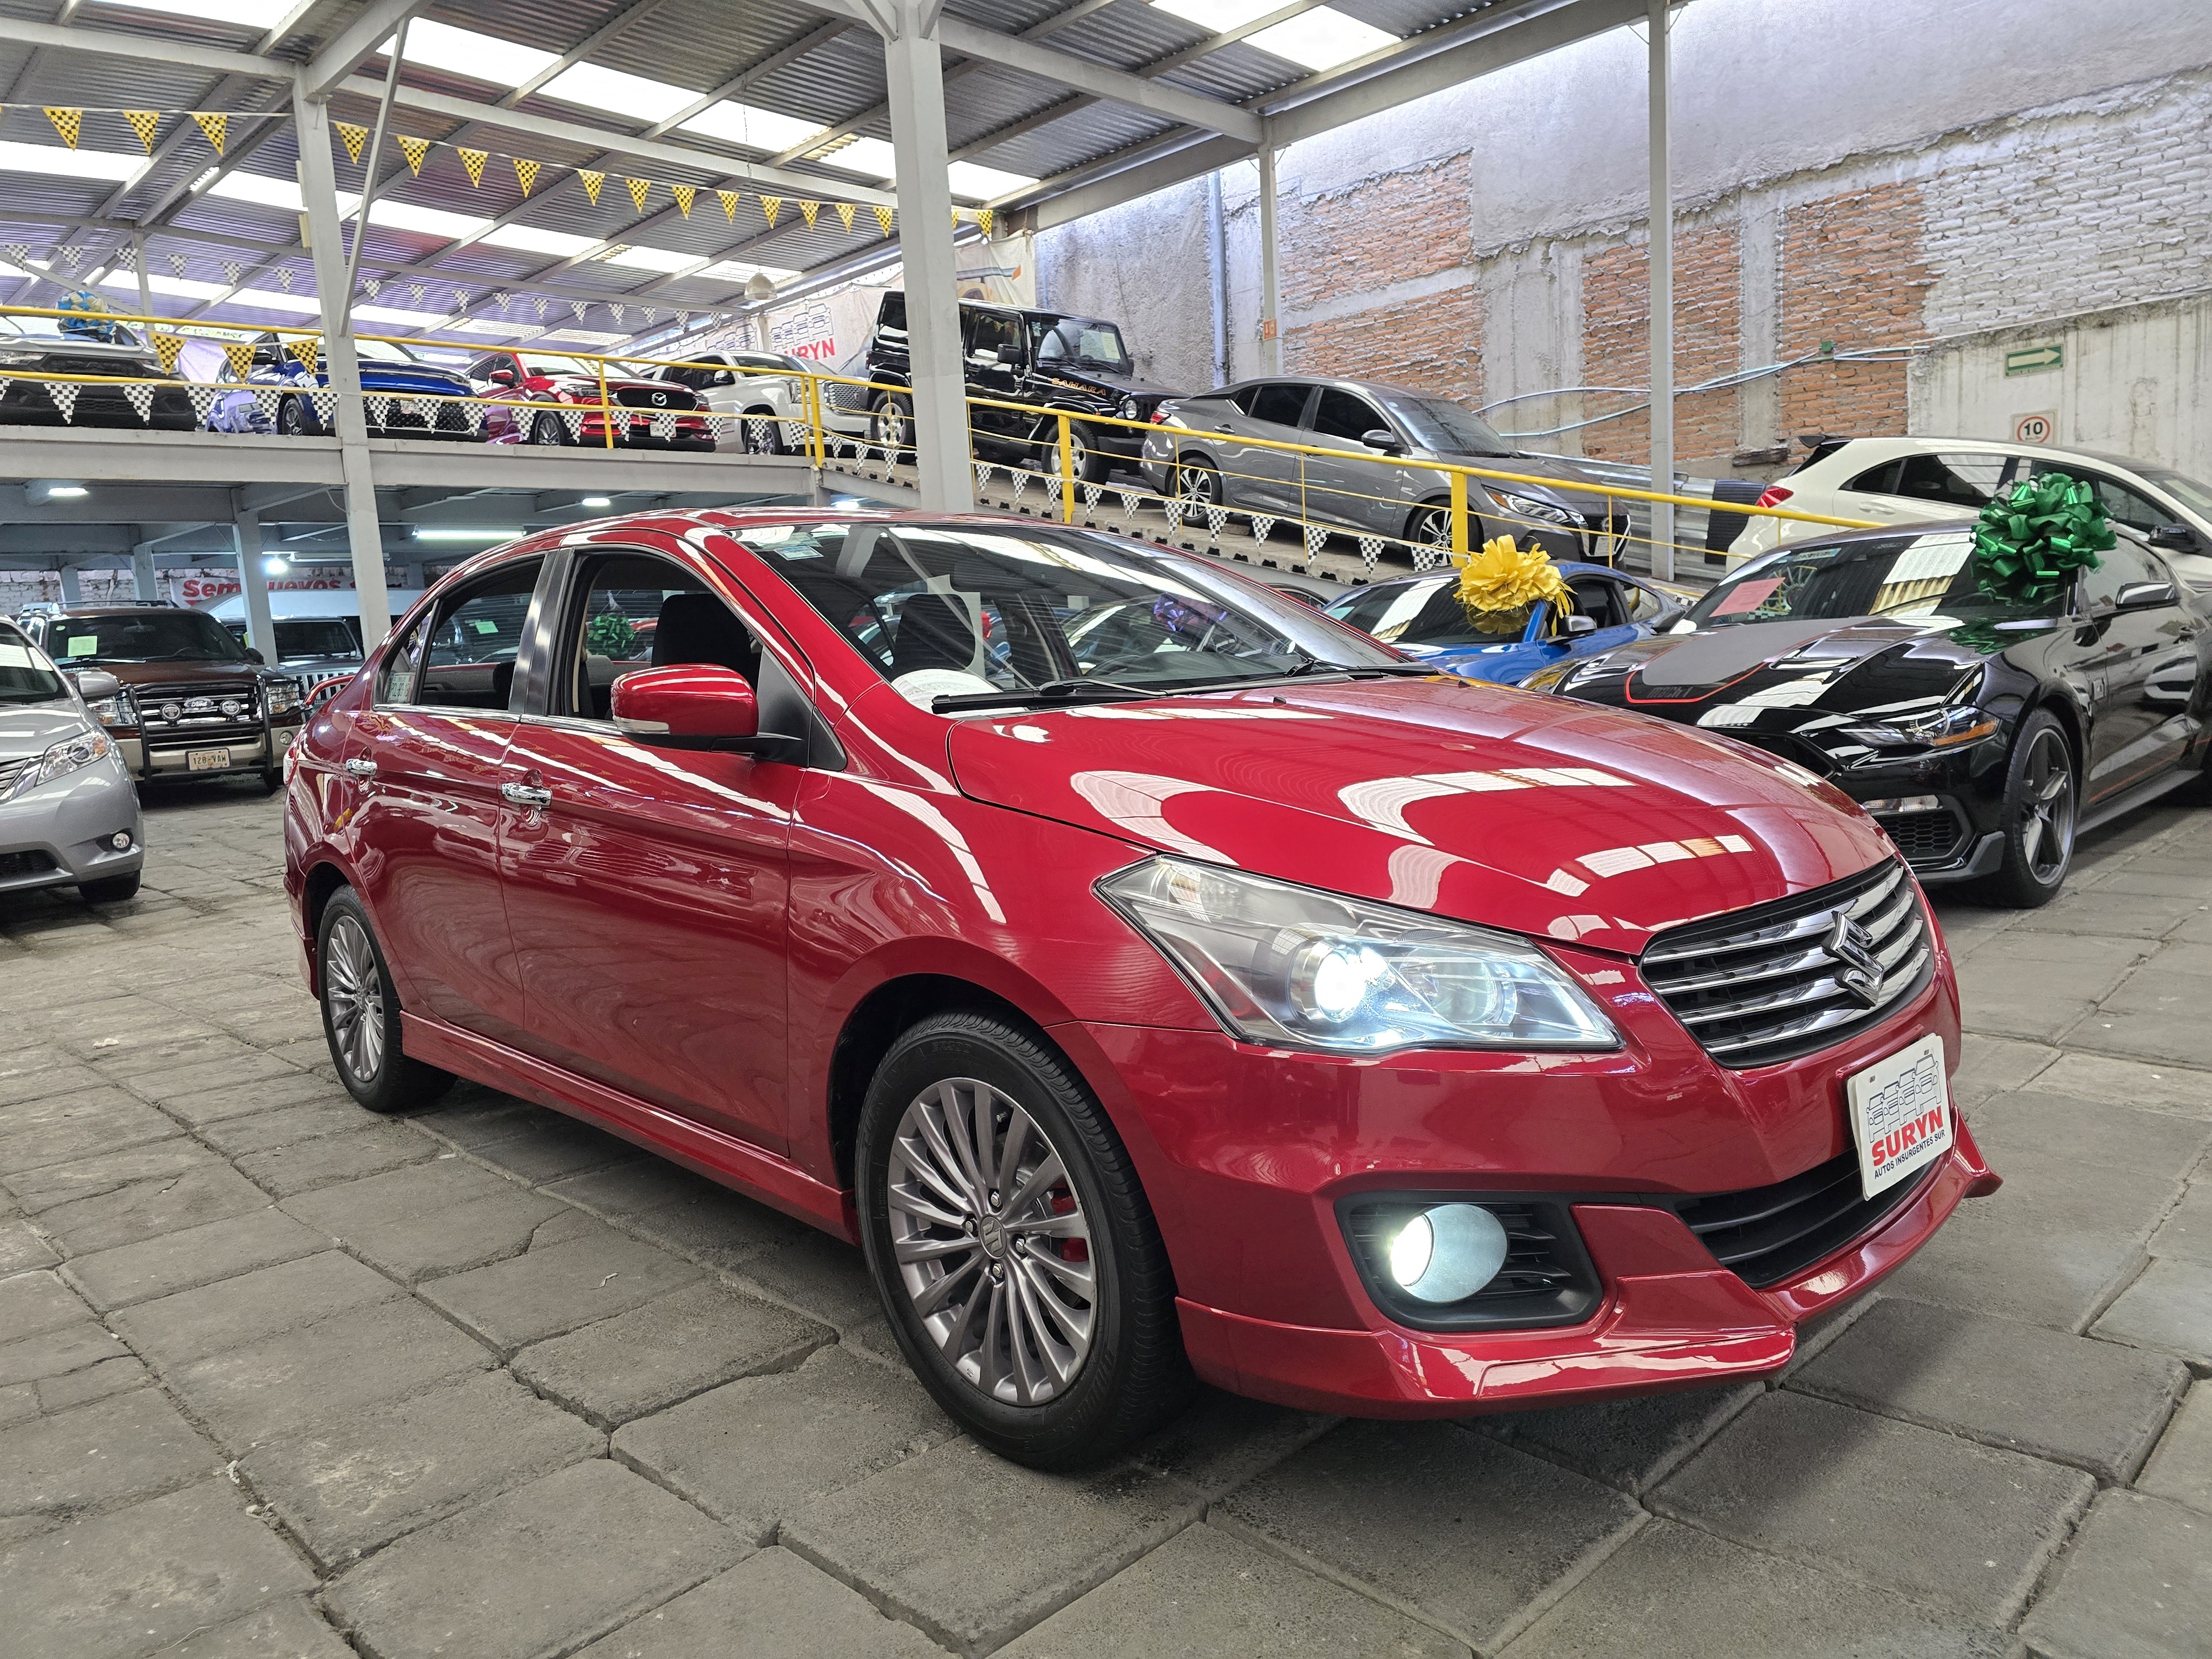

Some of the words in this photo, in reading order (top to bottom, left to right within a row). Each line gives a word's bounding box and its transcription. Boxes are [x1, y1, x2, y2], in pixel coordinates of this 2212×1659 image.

[1052, 378, 1106, 395] SAHARA
[2024, 422, 2043, 435] 10
[1872, 1105, 1943, 1166] SURYN
[1875, 1161, 1895, 1179] AUTOS
[1896, 1136, 1933, 1166] INSURGENTES
[1934, 1129, 1945, 1141] SUR
